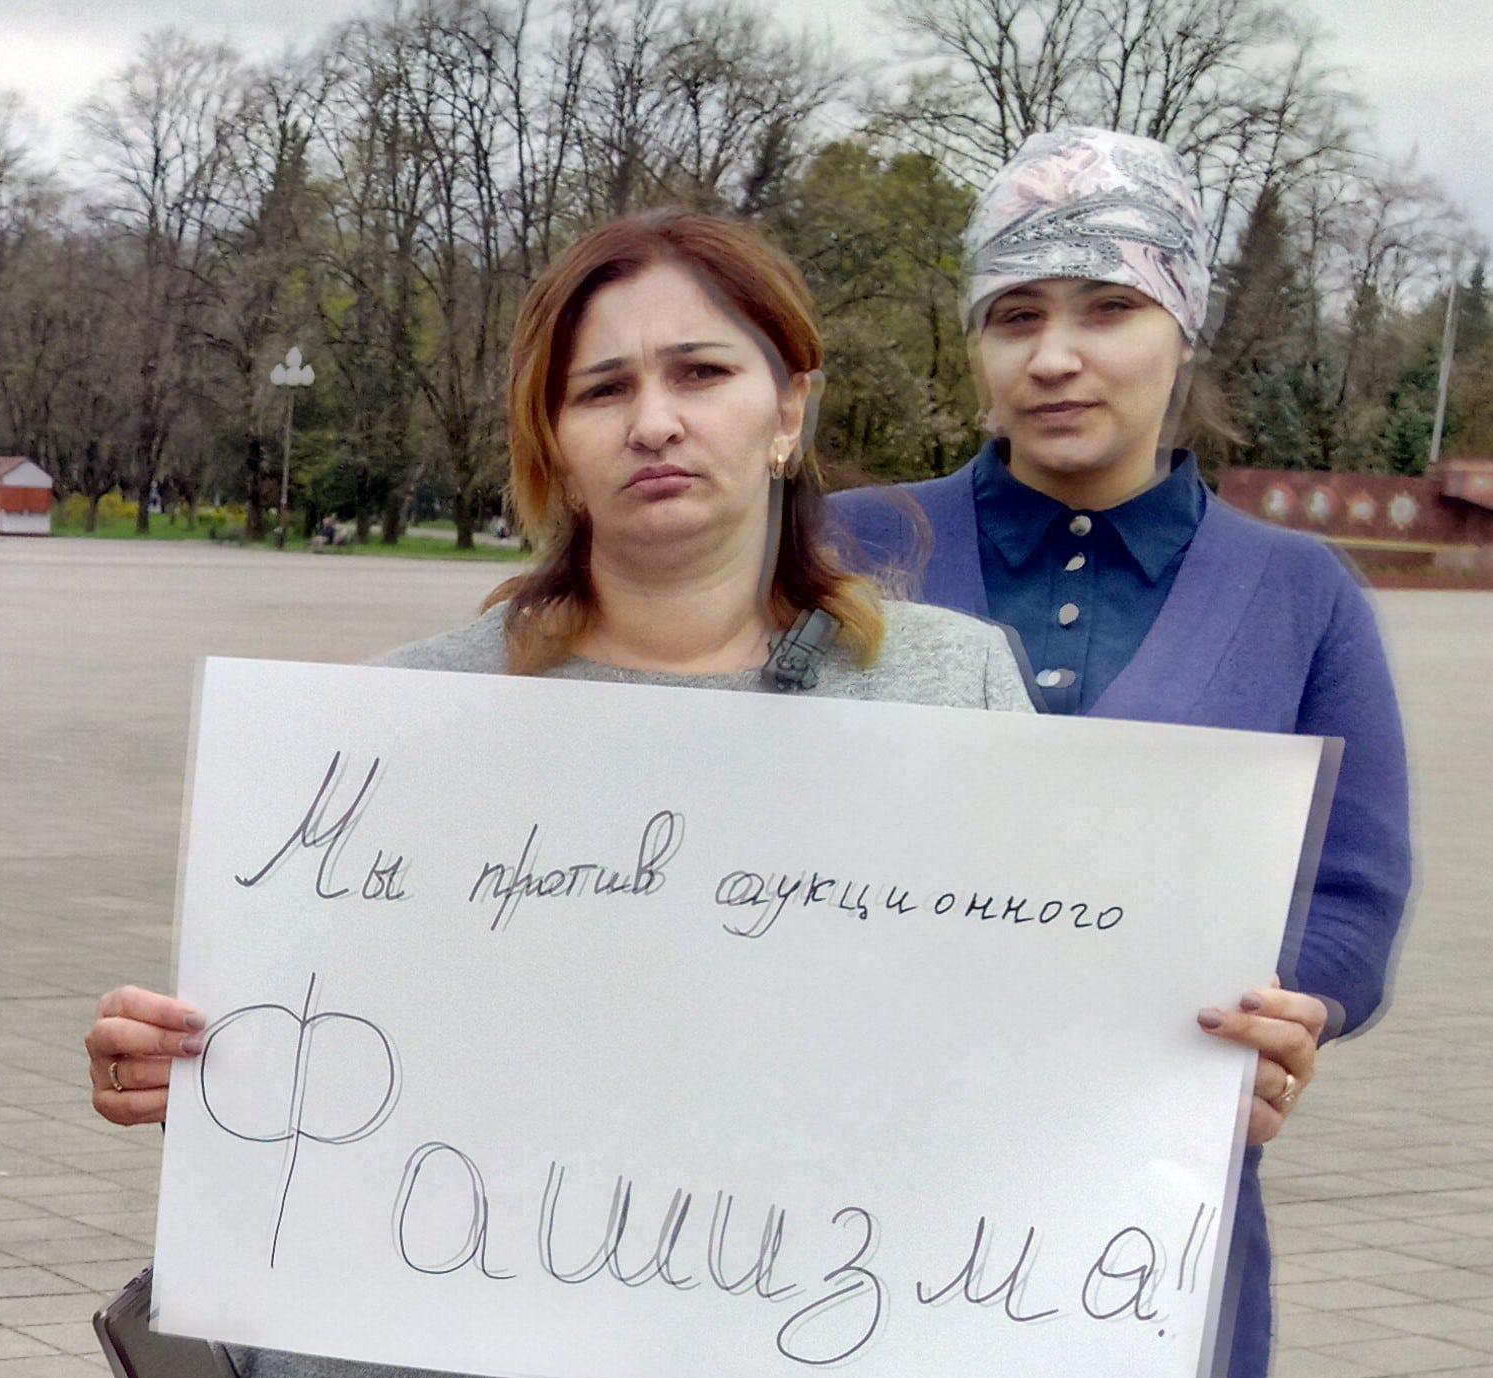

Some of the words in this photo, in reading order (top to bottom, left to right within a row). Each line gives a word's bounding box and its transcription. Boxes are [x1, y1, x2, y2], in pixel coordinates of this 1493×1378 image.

[234, 750, 409, 903] Мы
[468, 810, 687, 932] против
[715, 861, 1125, 938] аукционного
